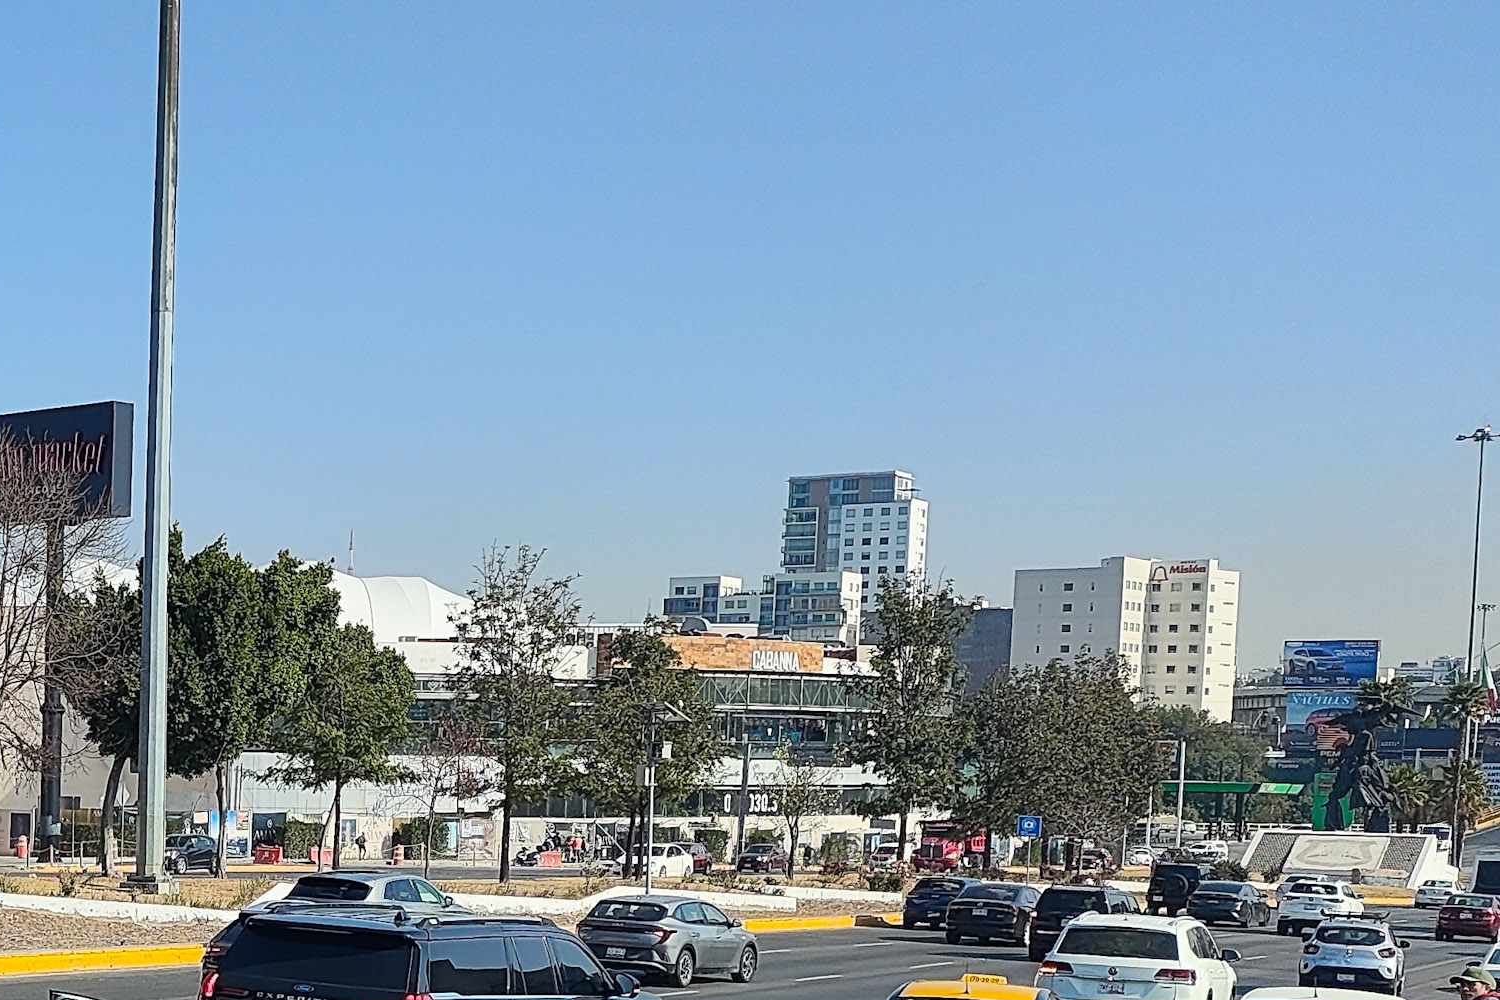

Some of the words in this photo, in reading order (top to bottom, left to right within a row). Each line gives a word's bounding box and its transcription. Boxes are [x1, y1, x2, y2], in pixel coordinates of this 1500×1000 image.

[32, 431, 107, 475] market
[752, 650, 800, 672] CABANNA
[1320, 750, 1341, 758] PEM
